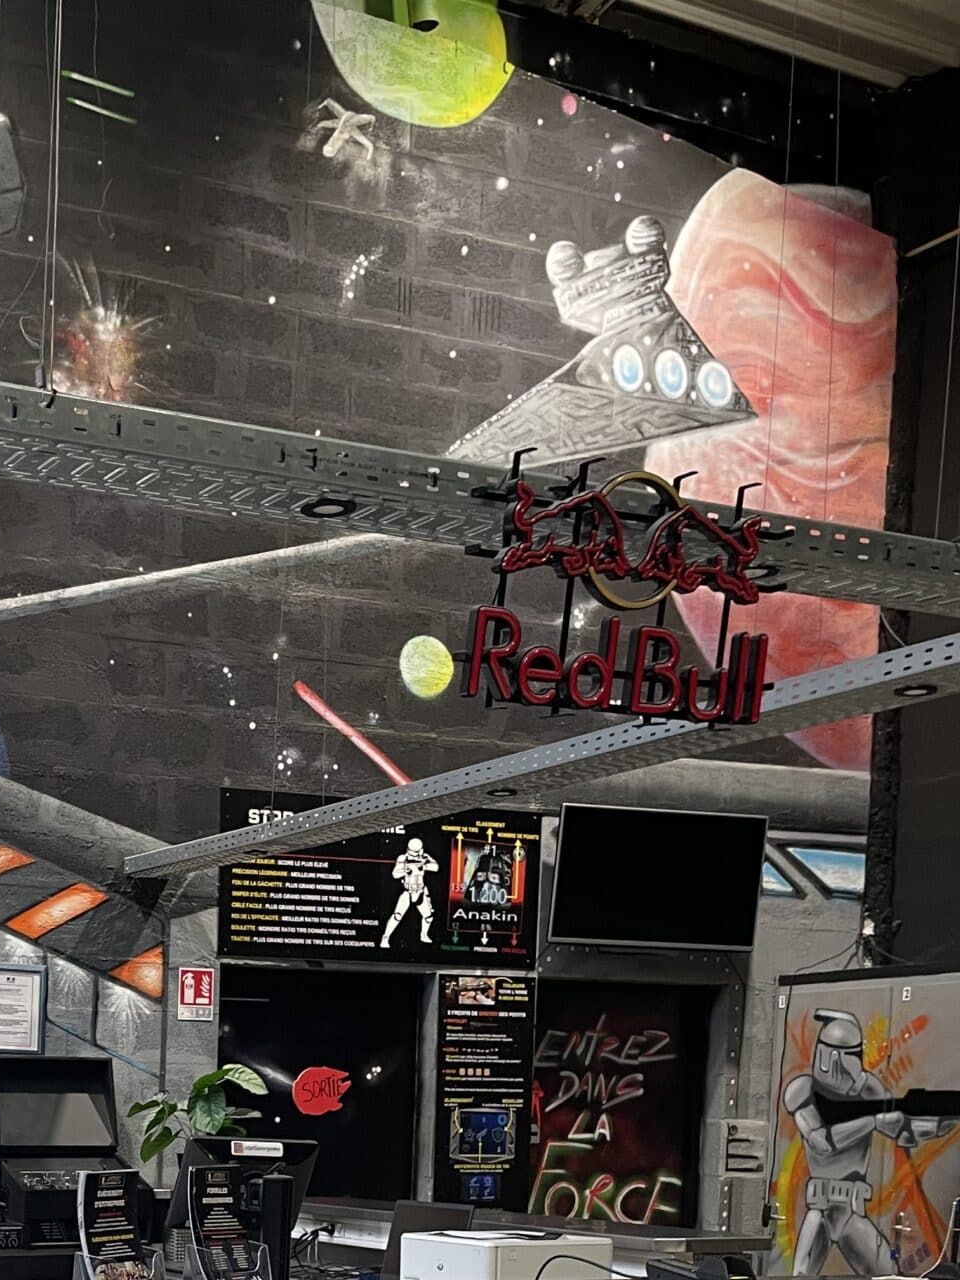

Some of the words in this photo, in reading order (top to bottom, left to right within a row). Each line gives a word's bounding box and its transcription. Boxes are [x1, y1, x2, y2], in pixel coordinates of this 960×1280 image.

[464, 605, 620, 710] Red
[630, 625, 769, 725] Bull
[452, 908, 518, 922] Anakin
[533, 1012, 678, 1067] ENTREZ
[567, 1110, 611, 1141] LA
